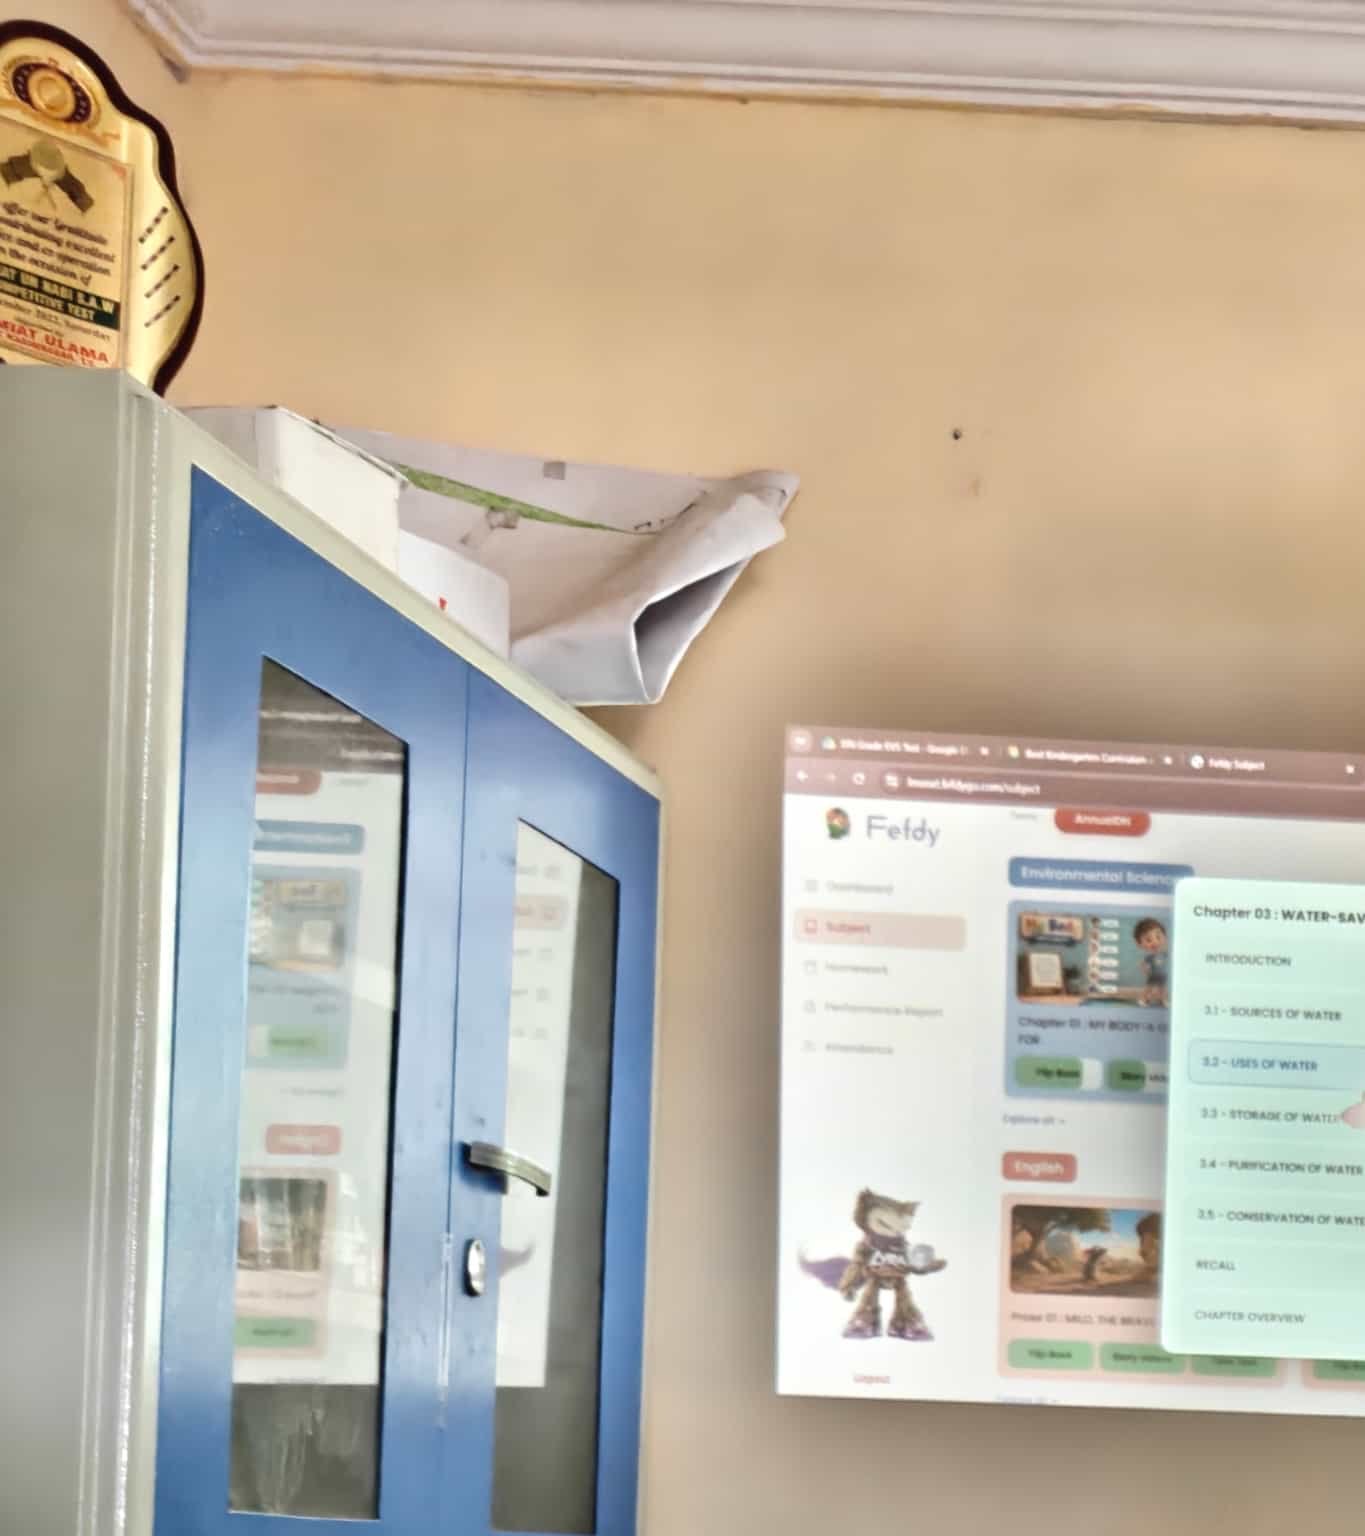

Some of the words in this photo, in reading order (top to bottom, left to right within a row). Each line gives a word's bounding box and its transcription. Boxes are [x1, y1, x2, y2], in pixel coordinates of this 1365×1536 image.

[1020, 864, 1123, 884] Environmental
[1193, 905, 1251, 921] Chapter
[1254, 908, 1272, 921] 03
[1205, 952, 1292, 967] INTRODUCTION
[1230, 1006, 1282, 1020] SOURCES
[1285, 1008, 1300, 1020] OF
[1303, 1009, 1343, 1021] WATER
[1231, 1057, 1260, 1070] USES
[1261, 1058, 1276, 1070] OF
[1279, 1059, 1318, 1072] WATER
[1229, 1109, 1281, 1122] STORAGE
[1284, 1110, 1299, 1122] OF
[1228, 1160, 1305, 1173] PURIFICATION
[1308, 1163, 1323, 1174] OF
[1325, 1164, 1363, 1176] WATER
[1226, 1210, 1314, 1225] CONSERVATION
[1316, 1213, 1332, 1225] OF
[1195, 1259, 1236, 1271] RECALL
[1194, 1309, 1245, 1322] CHAPTER
[1247, 1311, 1306, 1324] OVERVIEW
